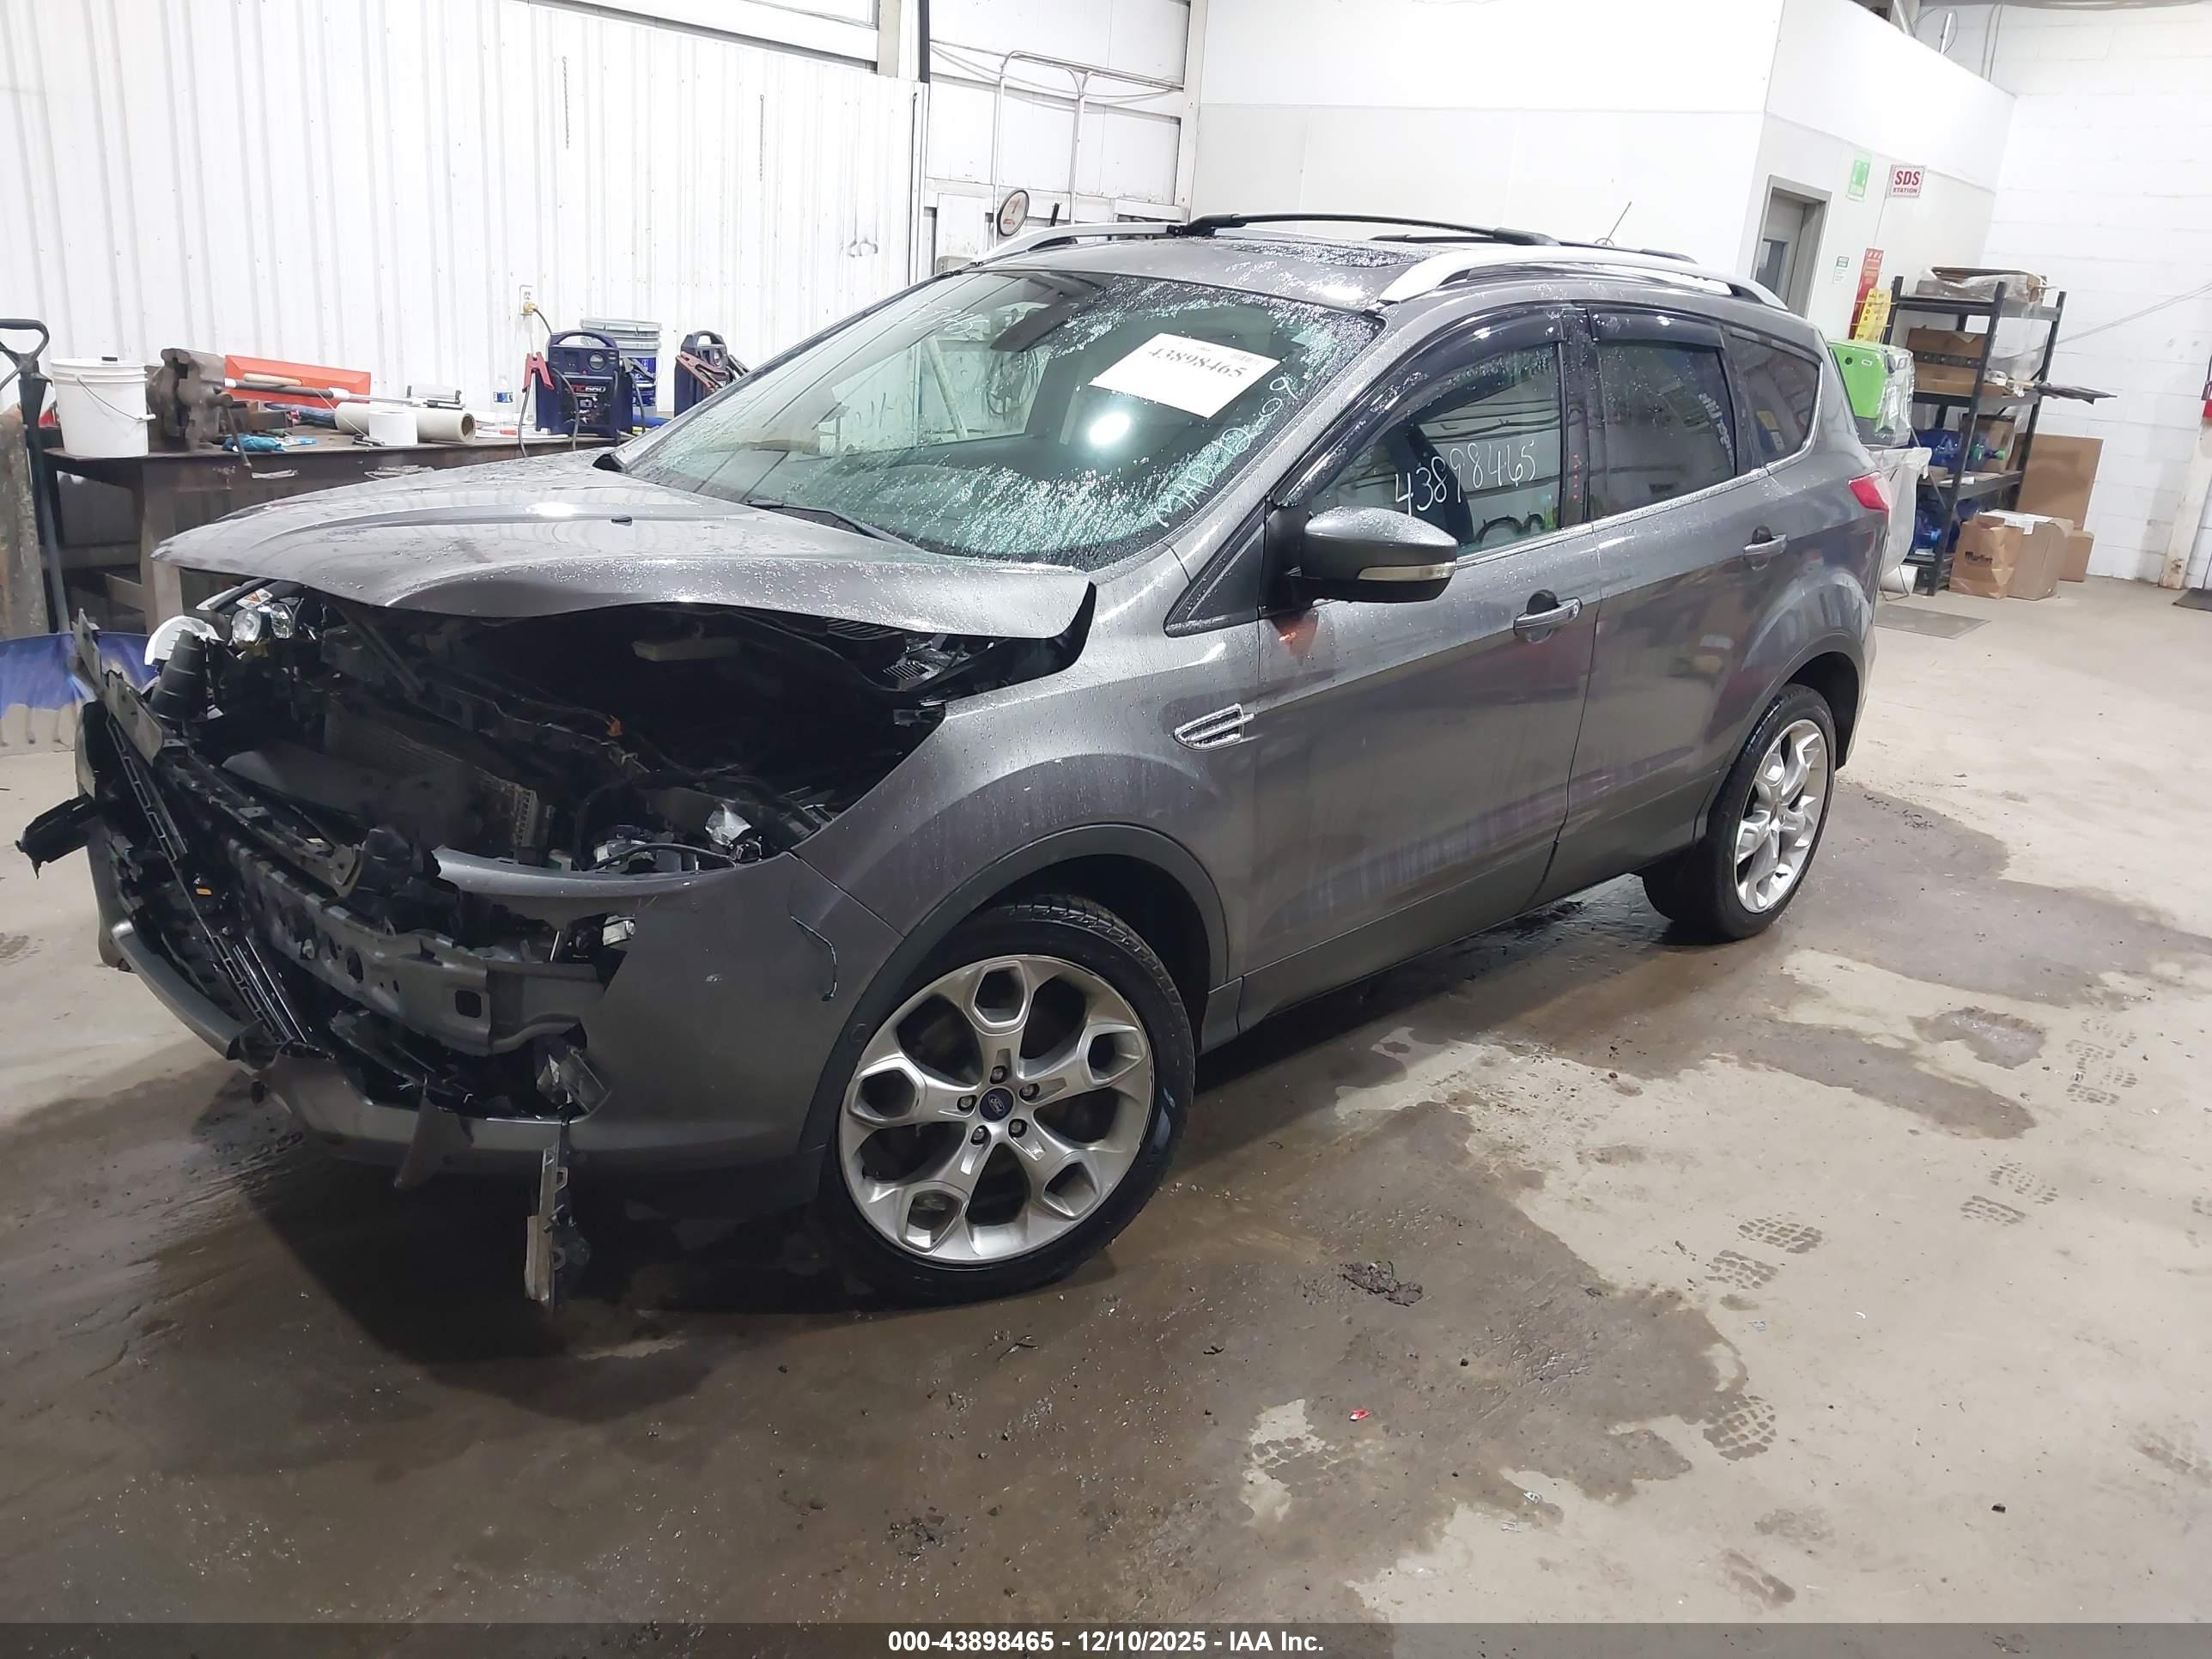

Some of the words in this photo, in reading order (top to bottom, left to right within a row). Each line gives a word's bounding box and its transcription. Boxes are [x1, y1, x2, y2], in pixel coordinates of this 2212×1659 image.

[1894, 170, 1921, 185] SDS
[1148, 348, 1248, 378] 43898465
[1395, 439, 1537, 517] 43898465
